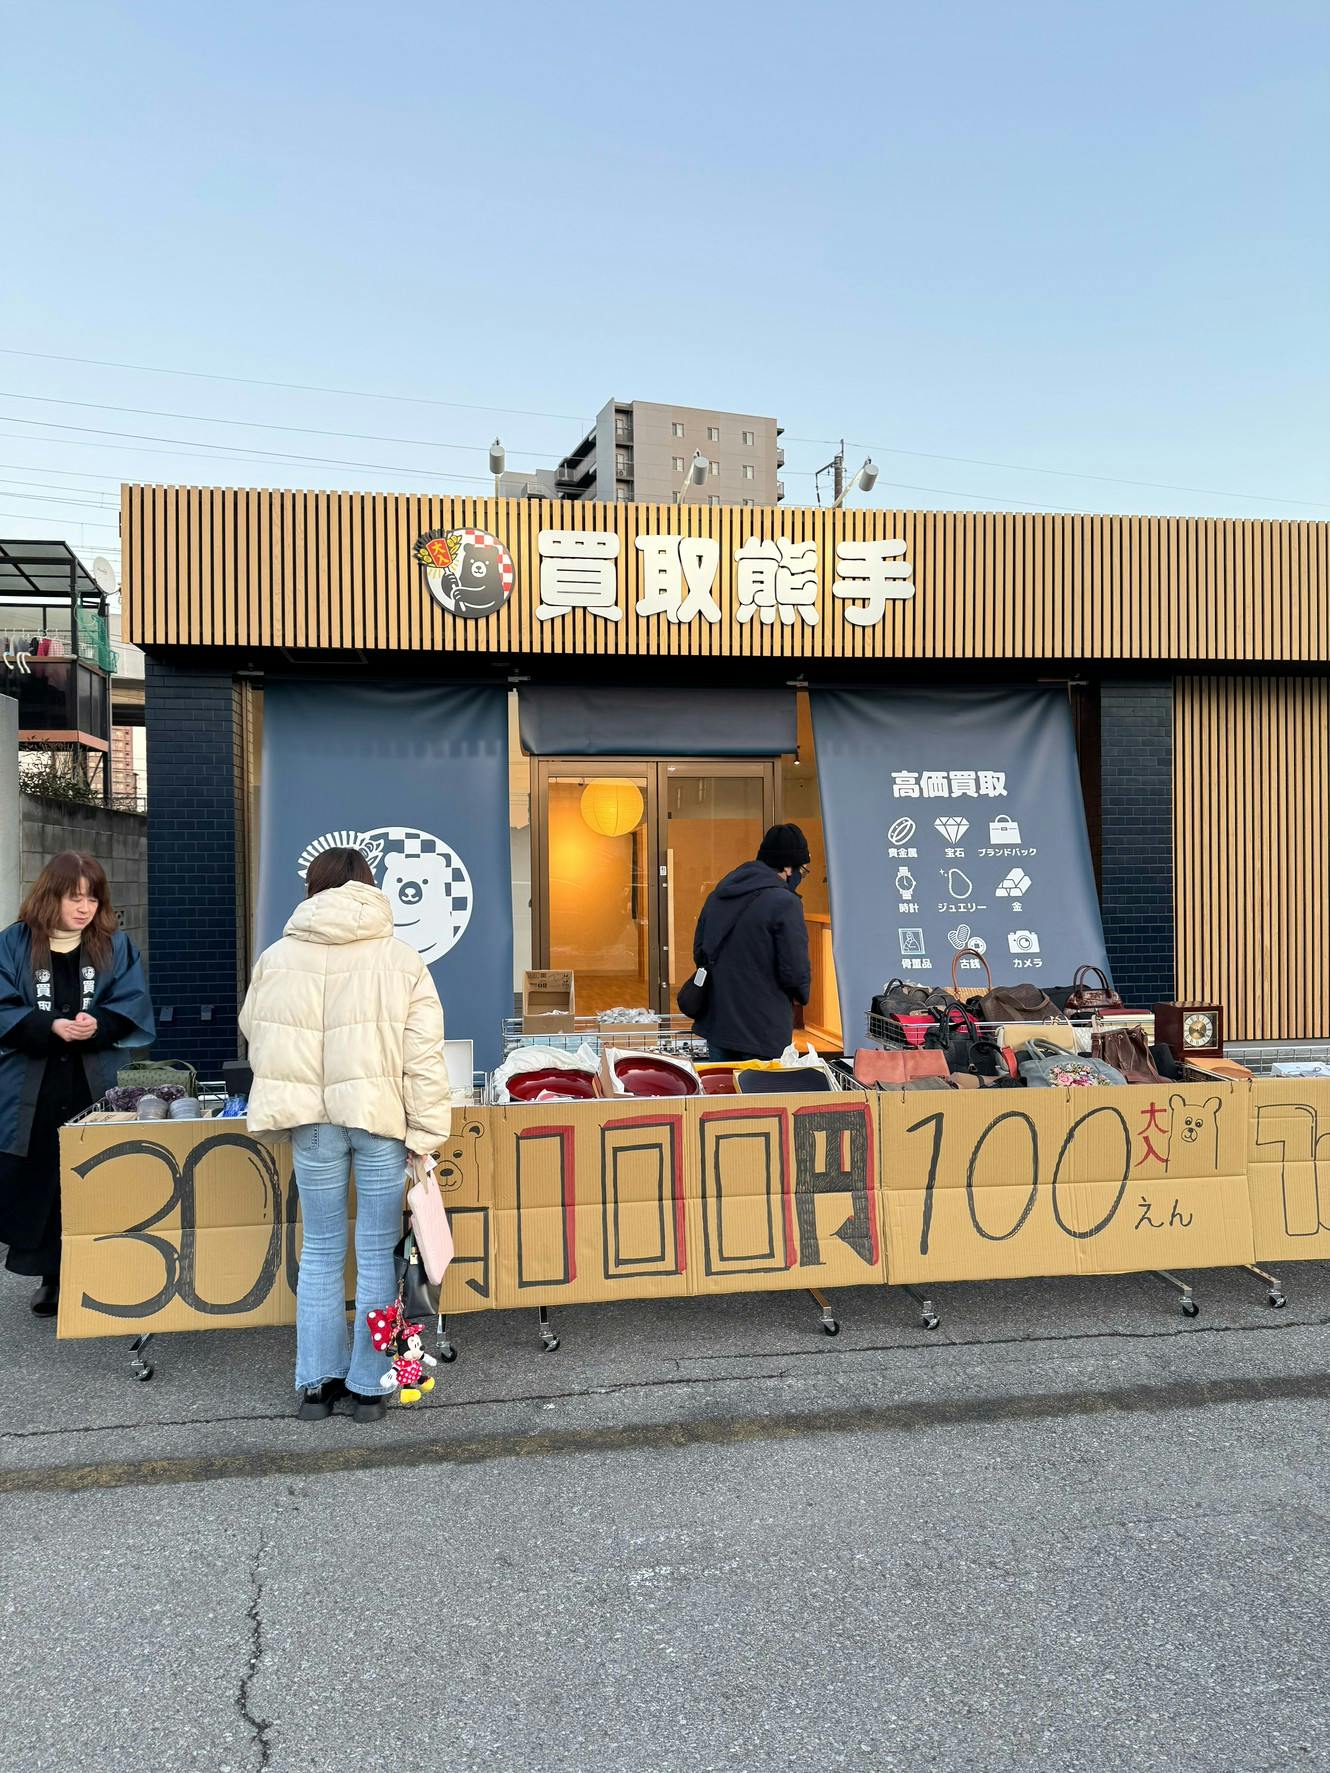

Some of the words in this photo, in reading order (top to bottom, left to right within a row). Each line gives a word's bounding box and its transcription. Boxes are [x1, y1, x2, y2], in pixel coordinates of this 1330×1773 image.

[536, 530, 915, 626] 買取熊手
[891, 770, 1008, 798] 高価買取
[945, 848, 965, 858] 宝石
[899, 903, 920, 913] 時計
[938, 903, 987, 912] ジュエリー
[1012, 901, 1023, 912] 金
[960, 959, 980, 969] 古銭
[1013, 959, 1042, 968] カメラ
[1135, 1197, 1193, 1230] えん
